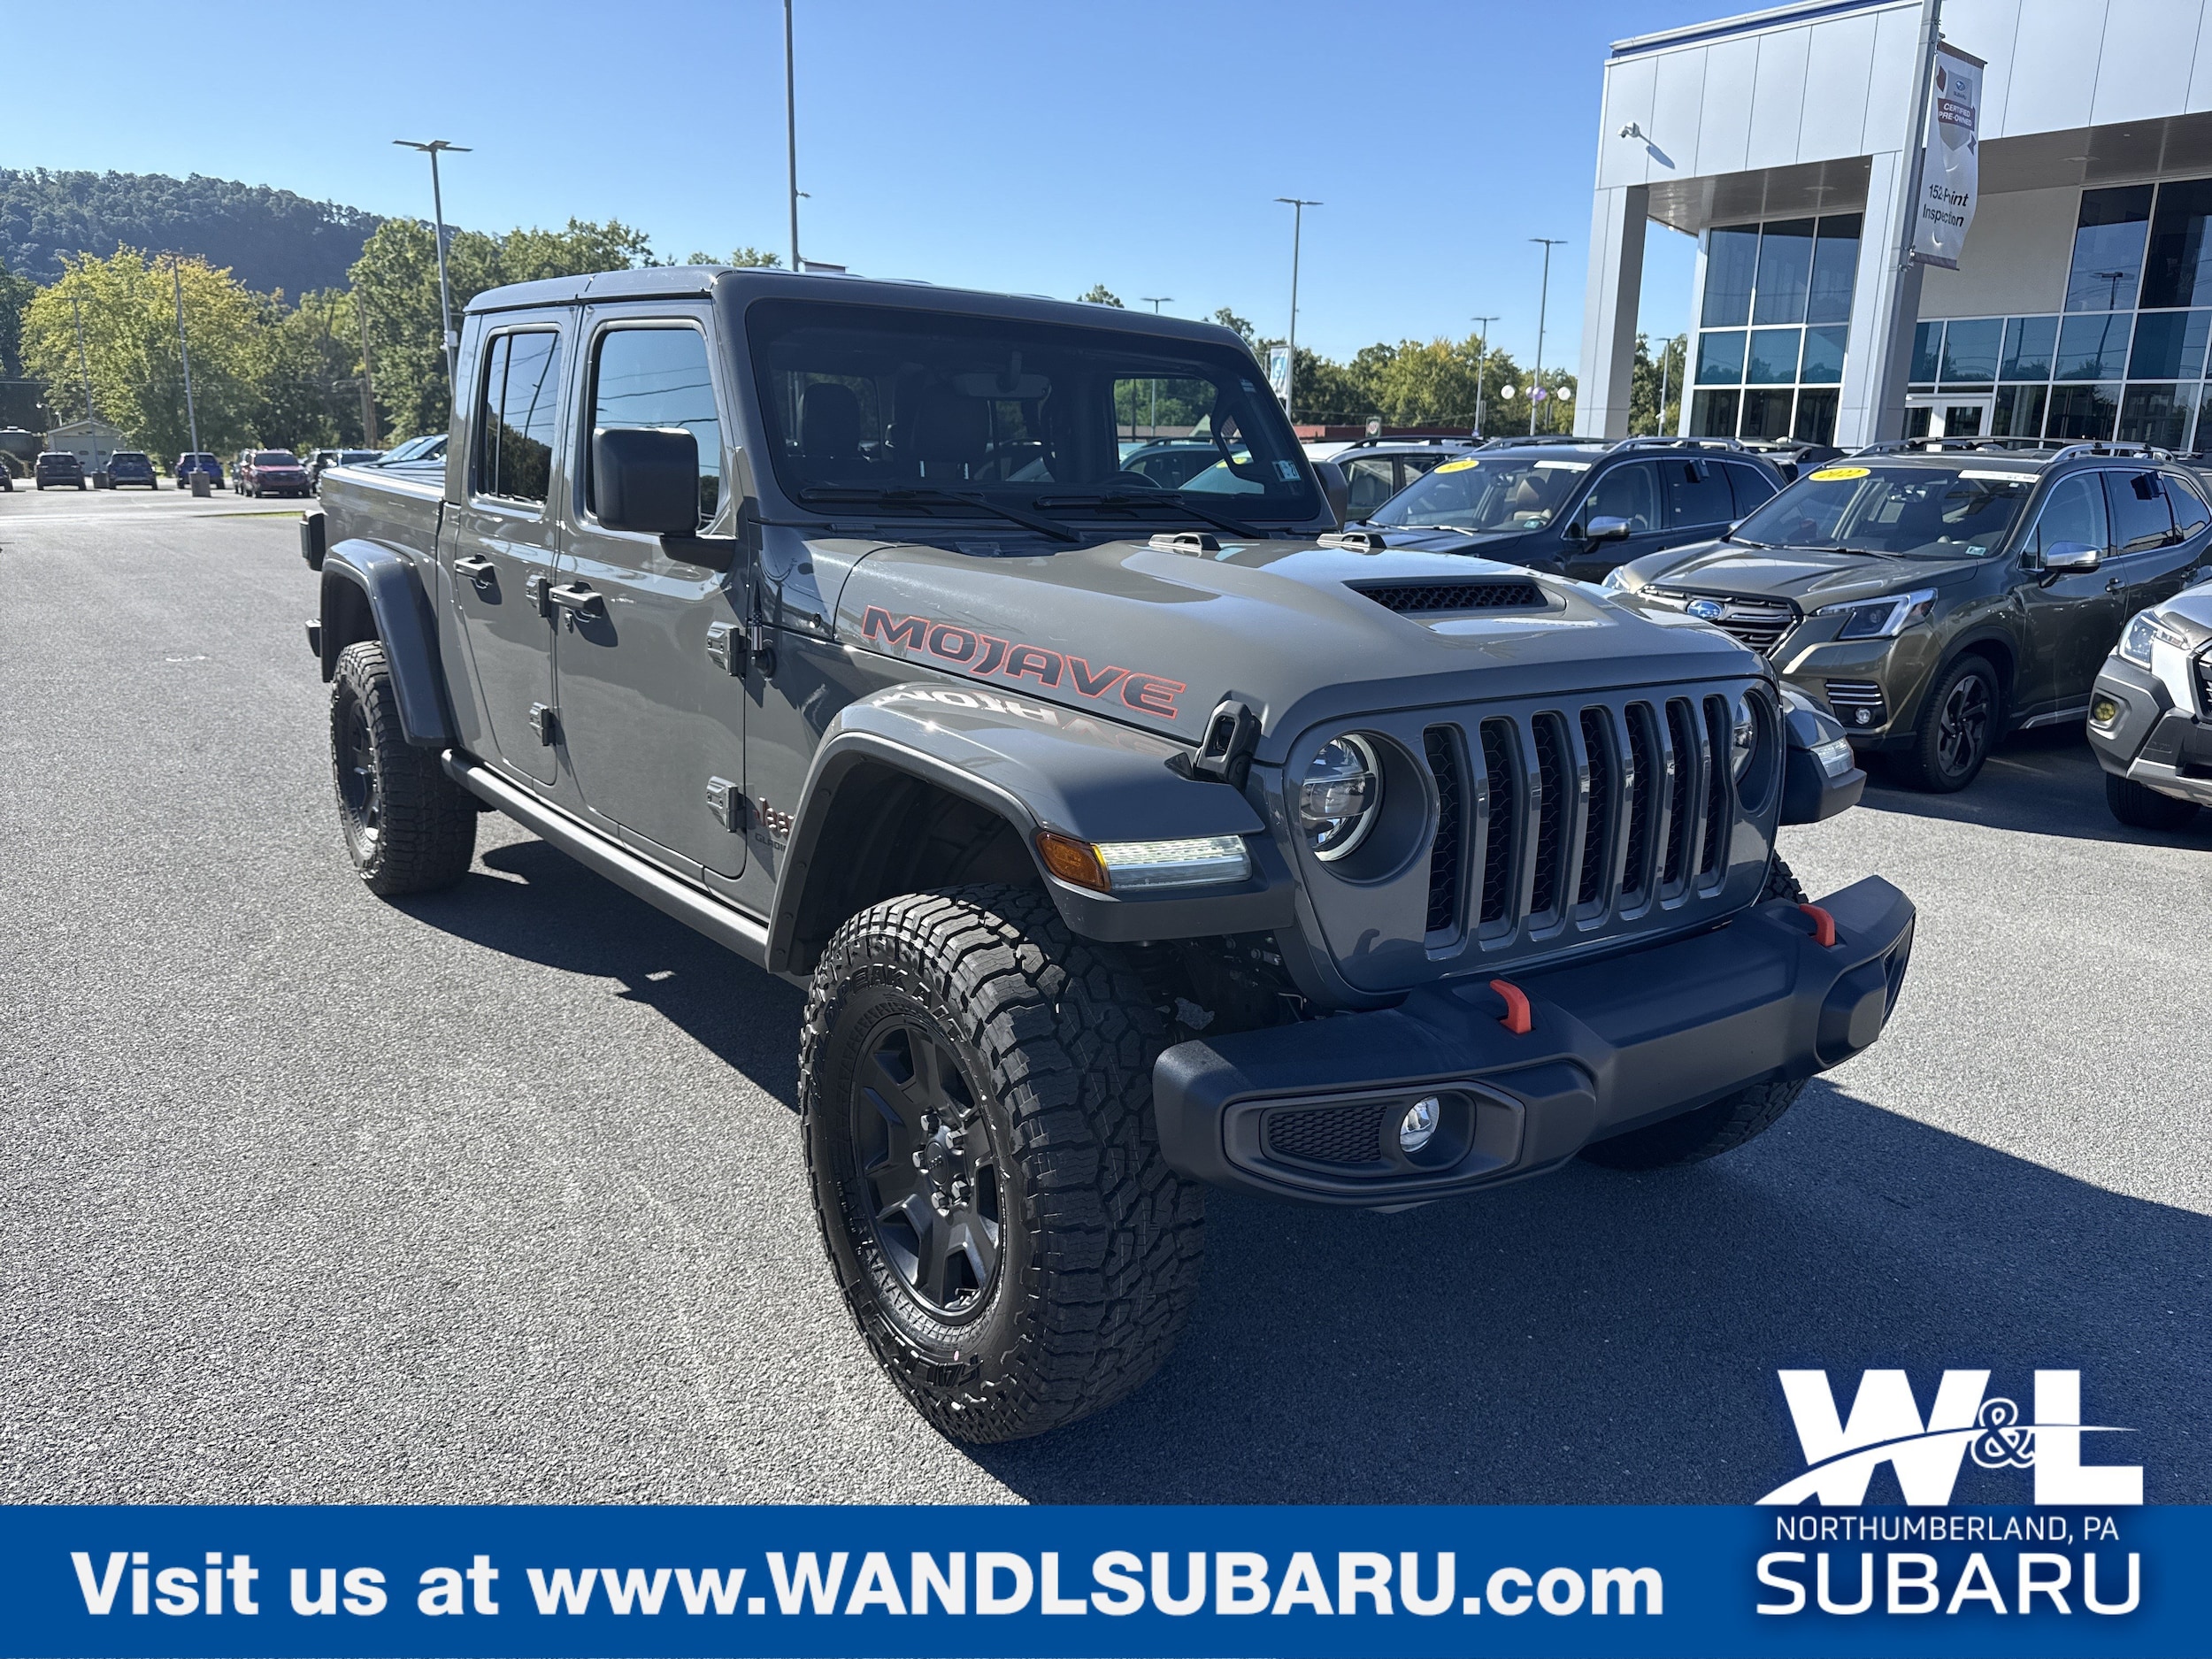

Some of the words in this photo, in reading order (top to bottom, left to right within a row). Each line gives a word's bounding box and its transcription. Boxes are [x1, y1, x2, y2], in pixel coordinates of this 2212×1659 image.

[1943, 103, 1971, 118] CERTIFIED
[1939, 111, 1973, 127] PRE-OWNED
[860, 604, 1187, 719] MOJAVE
